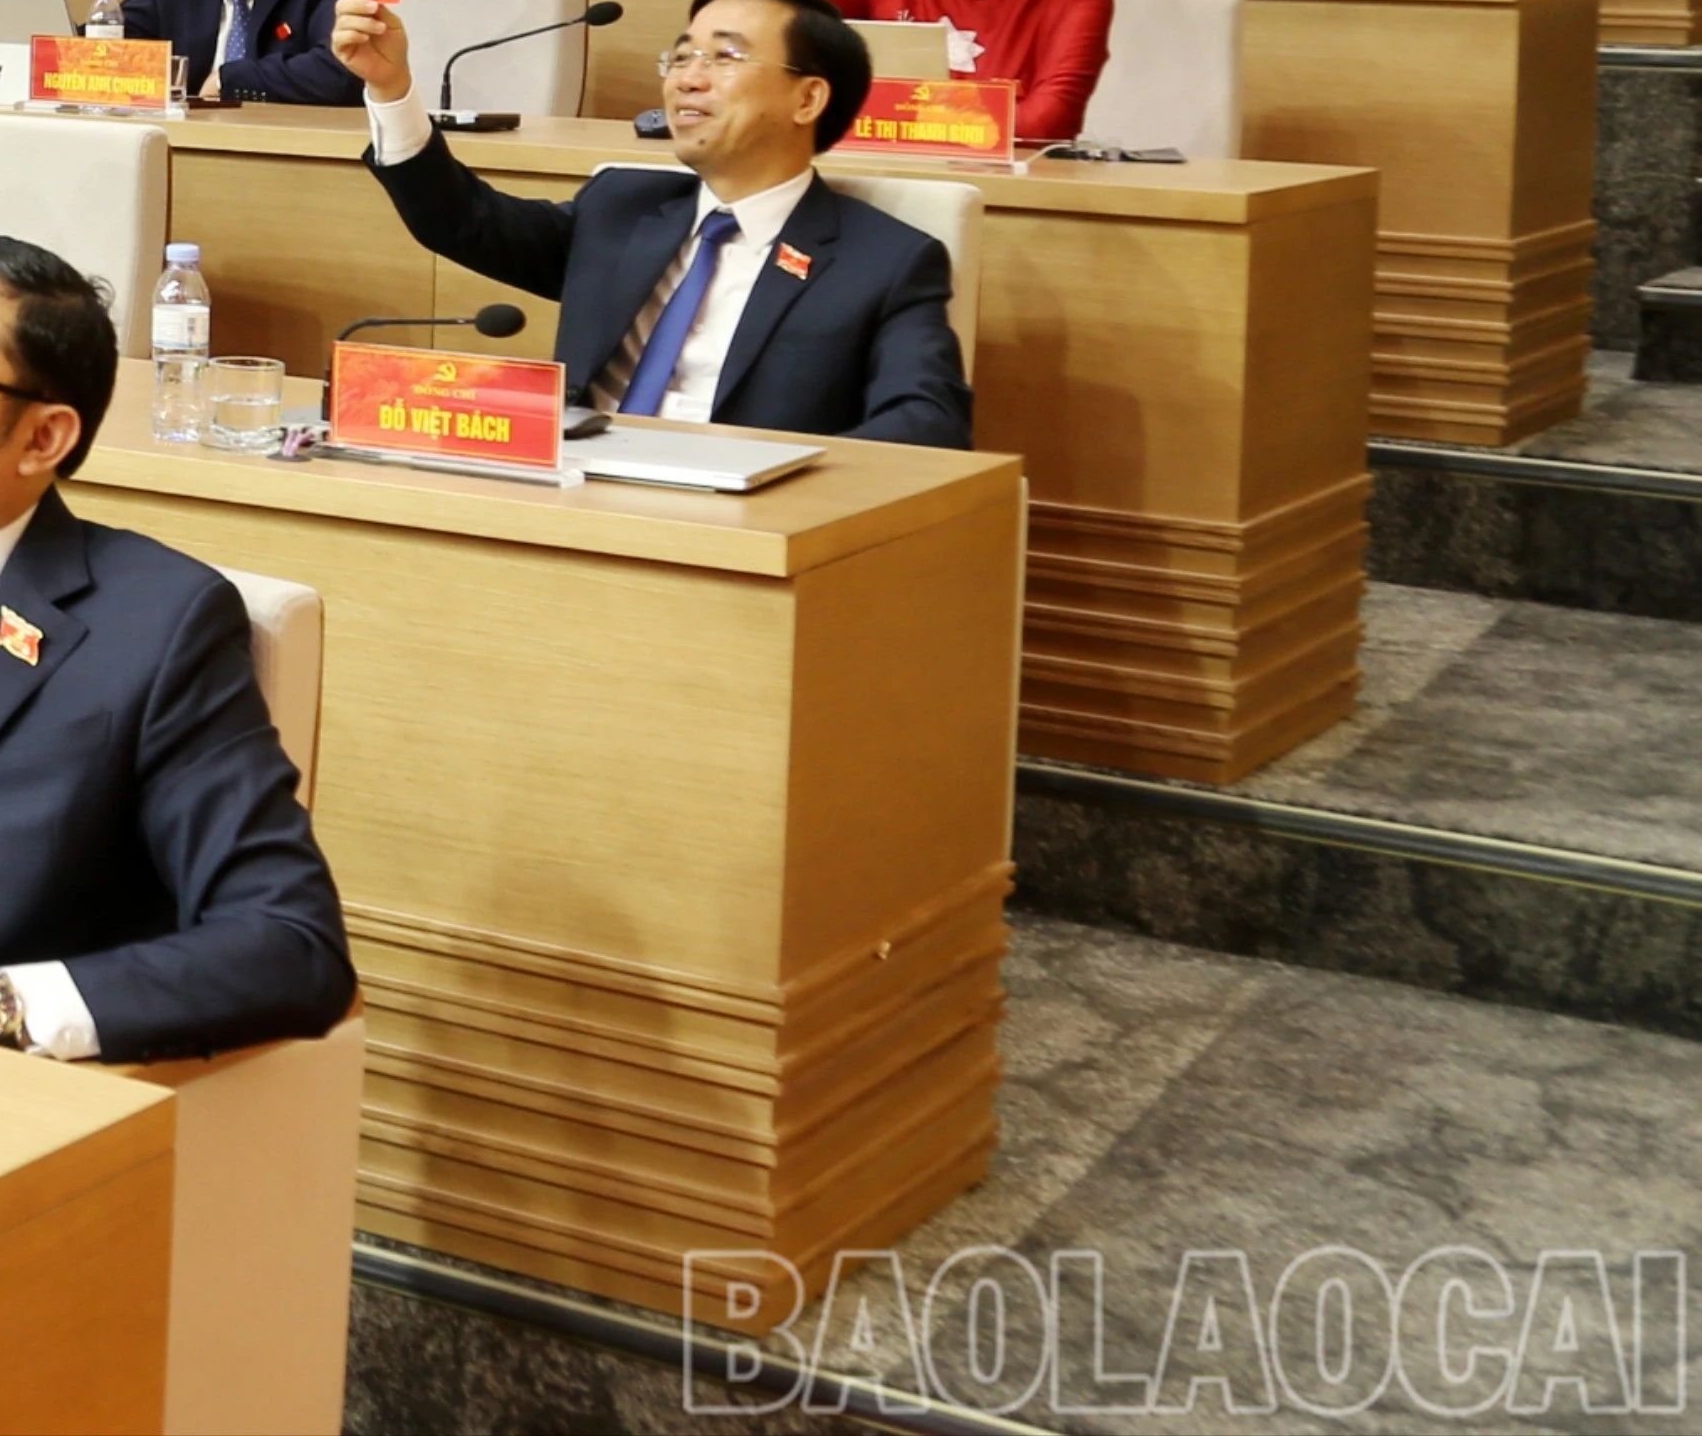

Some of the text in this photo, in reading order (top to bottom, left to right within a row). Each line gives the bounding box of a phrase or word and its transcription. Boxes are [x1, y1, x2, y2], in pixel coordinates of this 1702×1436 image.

[43, 68, 87, 91] NGUYỄN
[855, 115, 873, 139] LÊ
[874, 119, 898, 144] THỊ
[900, 120, 948, 143] THANH
[378, 397, 512, 443] ĐỖ VIỆT BÁCH
